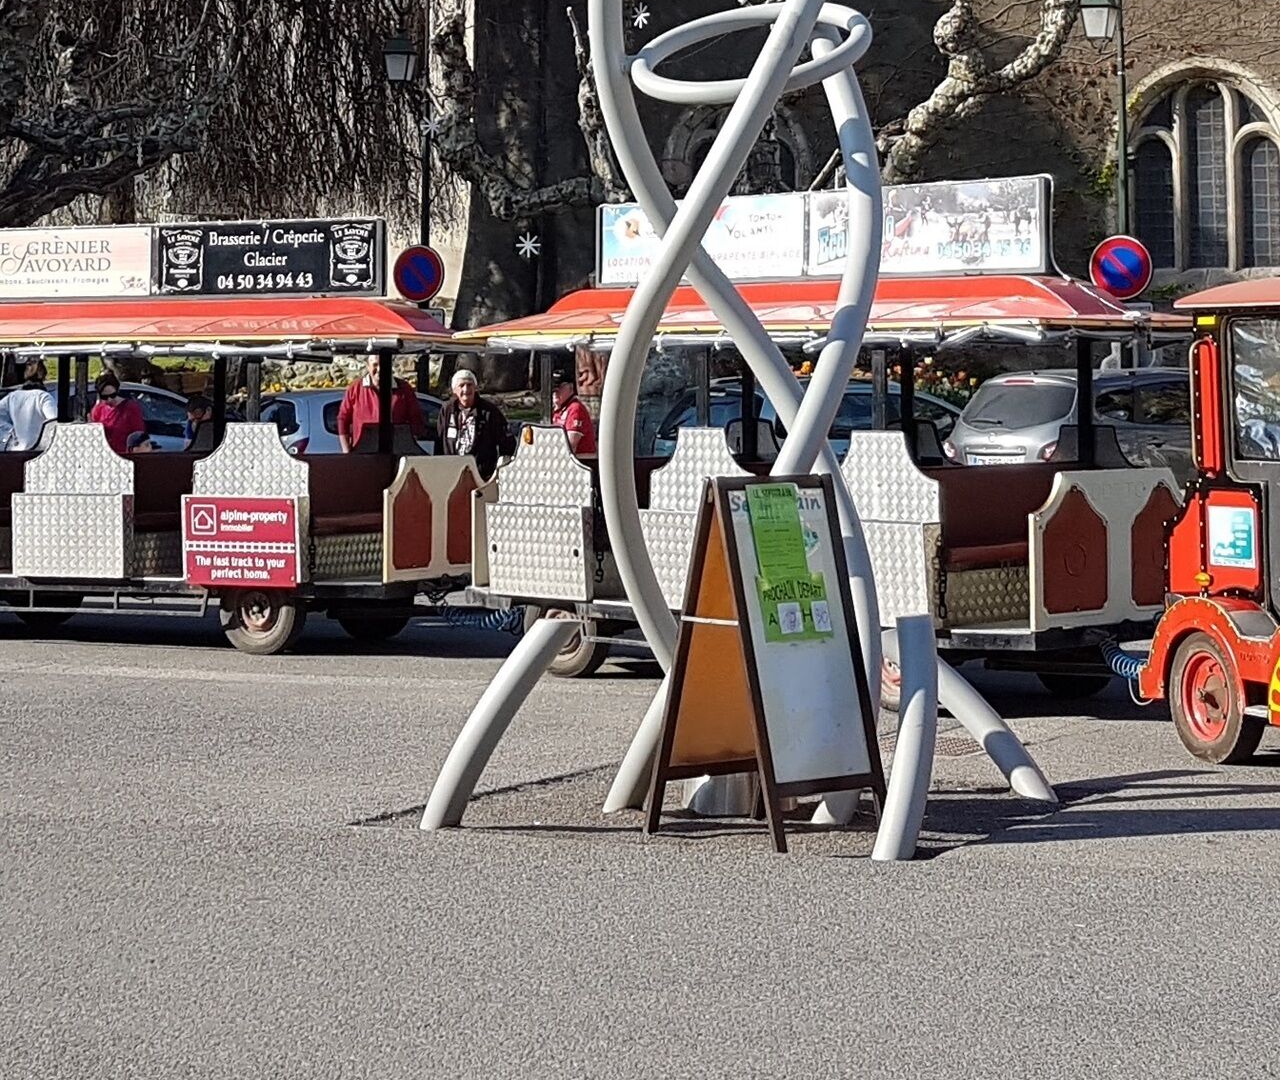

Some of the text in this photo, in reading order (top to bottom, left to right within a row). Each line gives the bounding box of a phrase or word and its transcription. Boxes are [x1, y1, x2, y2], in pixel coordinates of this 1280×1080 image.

[209, 230, 261, 247] Brasserie
[272, 228, 325, 248] Crêperie
[1, 244, 111, 275] SAVOYARD
[243, 251, 288, 267] Glacier
[217, 272, 313, 289] 04 50 34 94 43
[220, 509, 288, 525] alpine-property
[195, 554, 286, 570] The fast track to your
[210, 567, 271, 580] perfect home.
